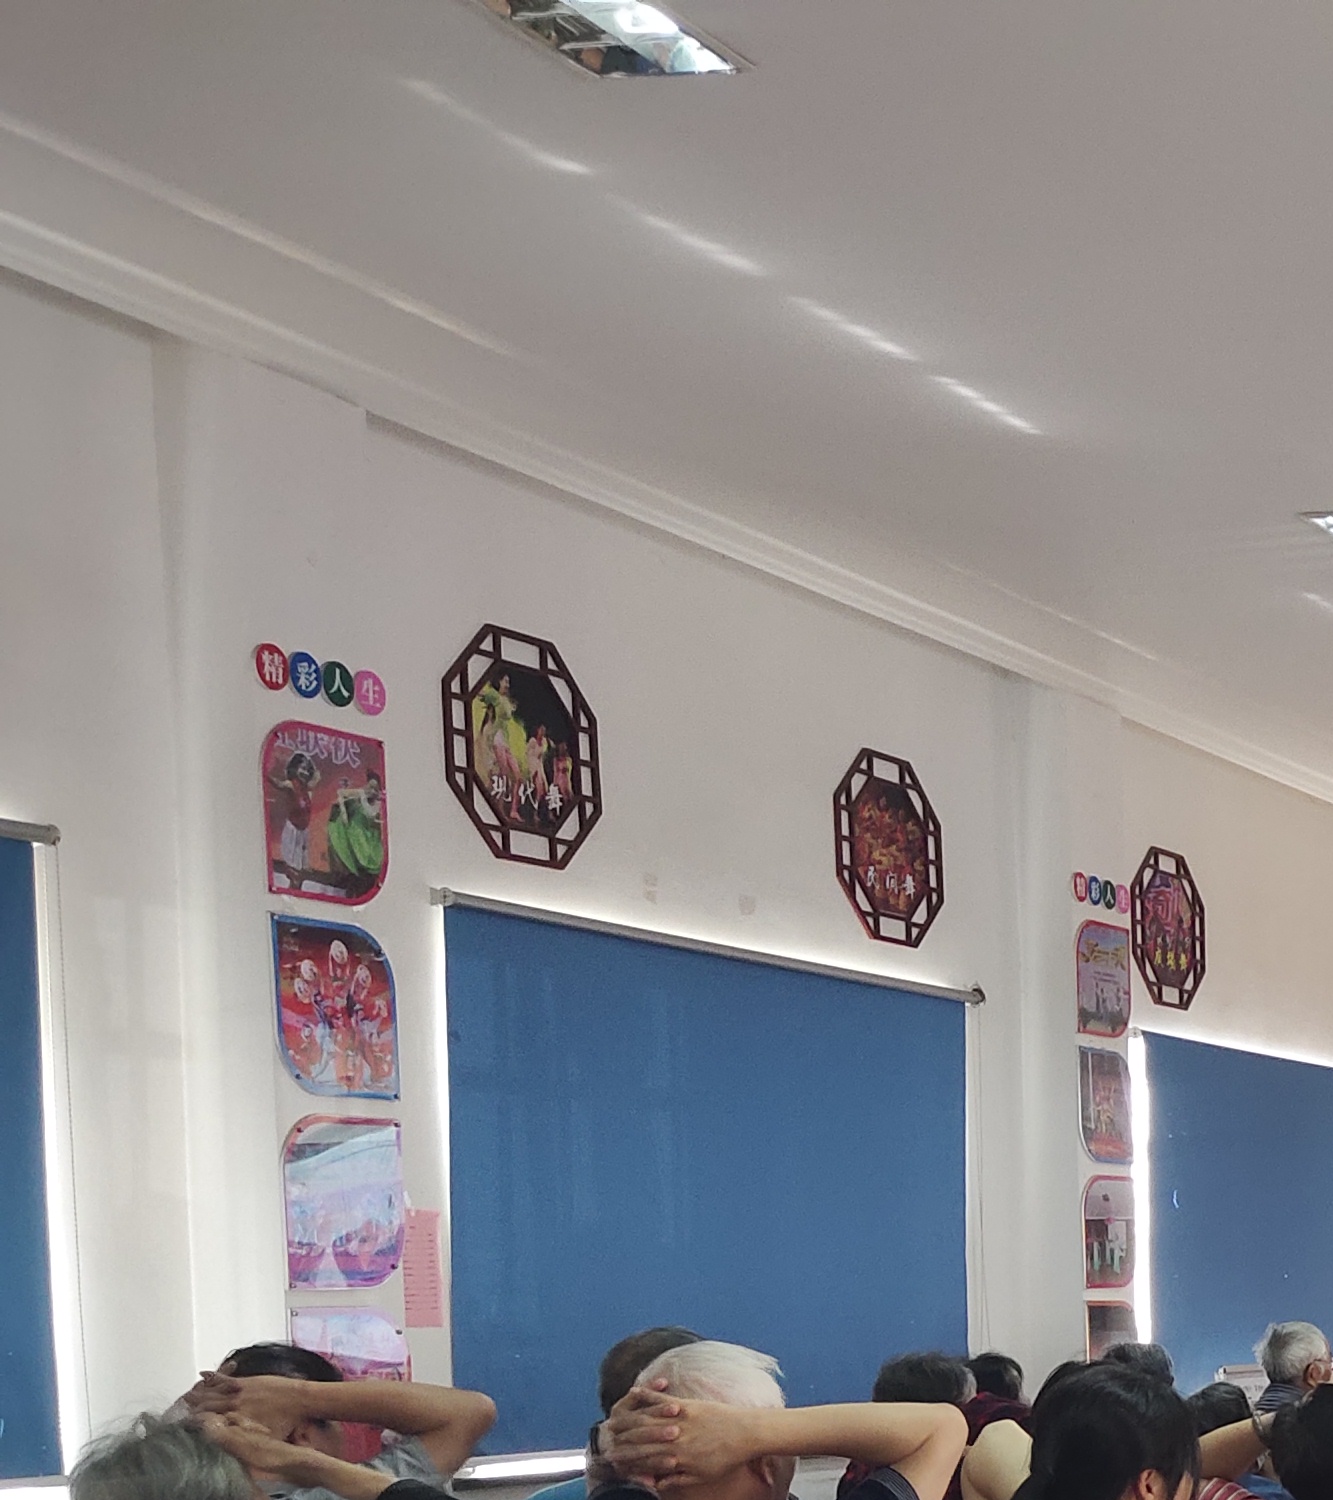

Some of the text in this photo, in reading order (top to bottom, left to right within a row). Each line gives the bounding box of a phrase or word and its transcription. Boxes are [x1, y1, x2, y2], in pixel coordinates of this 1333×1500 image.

[261, 649, 383, 708] 精彩人生
[491, 775, 562, 816] 现代舞
